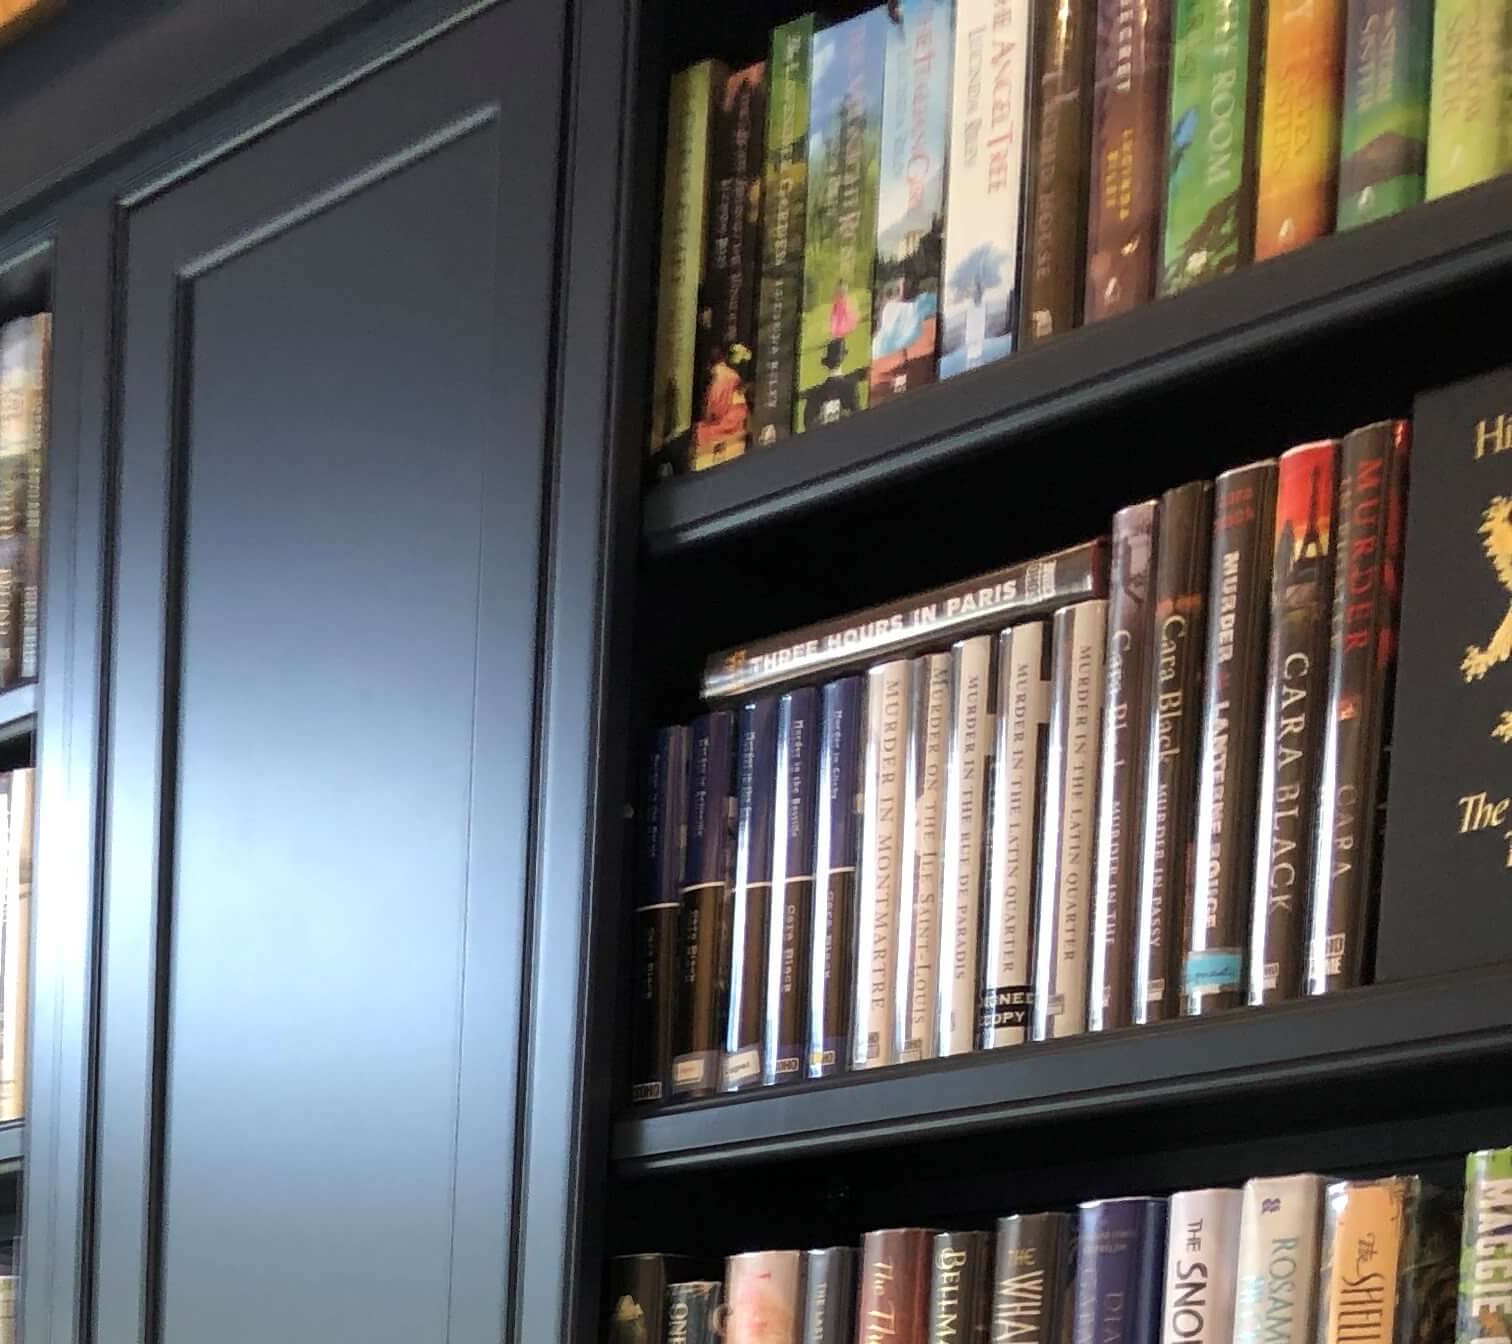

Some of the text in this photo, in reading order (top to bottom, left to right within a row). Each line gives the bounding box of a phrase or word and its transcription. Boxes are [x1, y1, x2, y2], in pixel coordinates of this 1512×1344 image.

[987, 42, 1017, 194] ANGEL TREE
[1204, 69, 1236, 190] ROOM
[1216, 552, 1240, 665] MURDER
[1343, 457, 1382, 653] MURDER
[750, 580, 1017, 672] THREE HOURS IN PARIS
[1156, 614, 1185, 763] Cara Black
[792, 719, 805, 758] Murder
[792, 761, 803, 773] in
[1063, 645, 1092, 962] MURDER IN THE LATIN QUARTER
[1207, 701, 1234, 835] LANTERNE
[1267, 652, 1311, 914] CARA BLACK
[870, 680, 900, 1011] MURDER IN MONTMARTRE
[912, 668, 947, 1025] MURDER ON THE SAINT-LOUIS
[954, 676, 979, 981] MURDER IN THE RUE DE PARADIS
[1002, 663, 1029, 973] MURDER IN THE LATIN QUARTER
[1150, 784, 1169, 948] MURDER IN PASSY
[1331, 784, 1359, 881] CARA
[873, 1260, 895, 1297] The
[1184, 1219, 1204, 1252] THE
[1471, 1178, 1512, 1318] MAGGIE
[813, 1311, 825, 1341] LAST
[1336, 1273, 1384, 1344] SHELL
